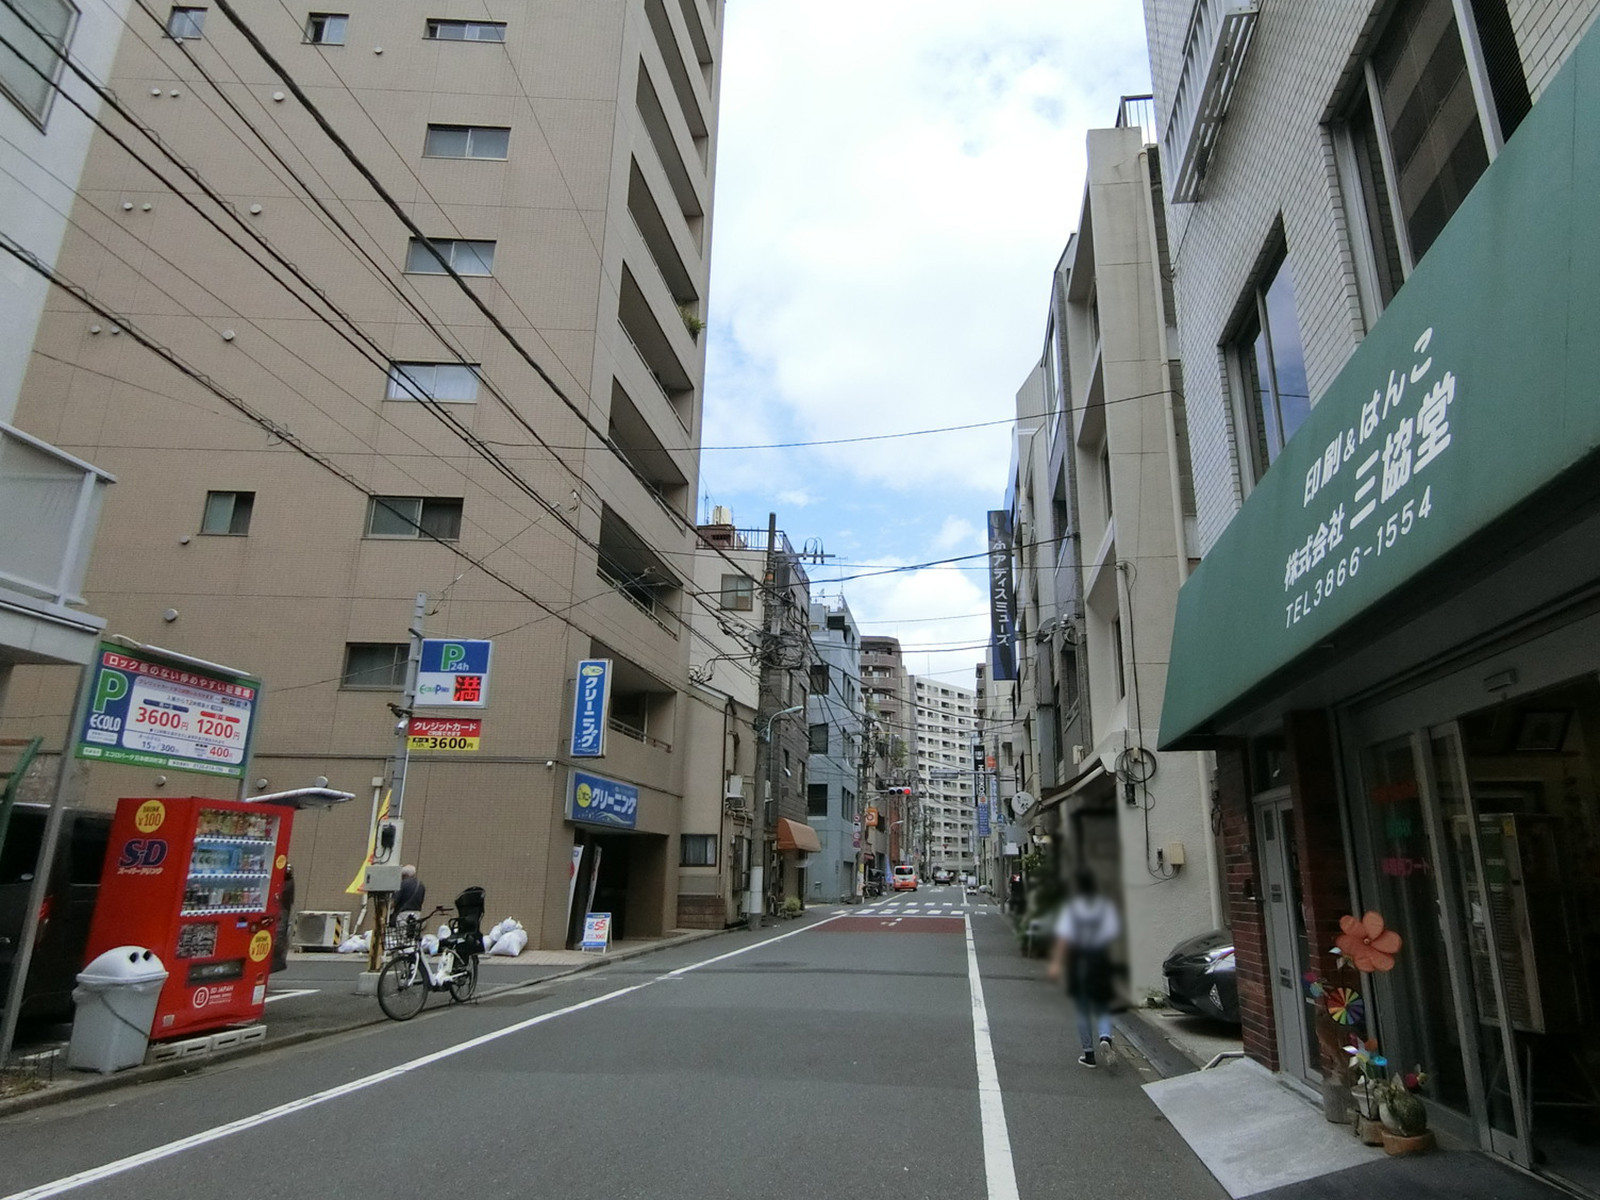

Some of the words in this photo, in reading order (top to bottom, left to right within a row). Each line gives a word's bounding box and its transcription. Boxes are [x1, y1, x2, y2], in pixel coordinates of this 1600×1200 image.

[1303, 326, 1433, 509] 印刷&はんこ
[440, 643, 466, 671] P
[451, 662, 470, 672] 24h
[92, 668, 129, 714] P
[452, 675, 482, 702] 満
[89, 713, 122, 732] ECOLO
[581, 676, 599, 748] クリーニング
[413, 721, 477, 732] クレジットカード
[591, 787, 637, 815] クリーニング
